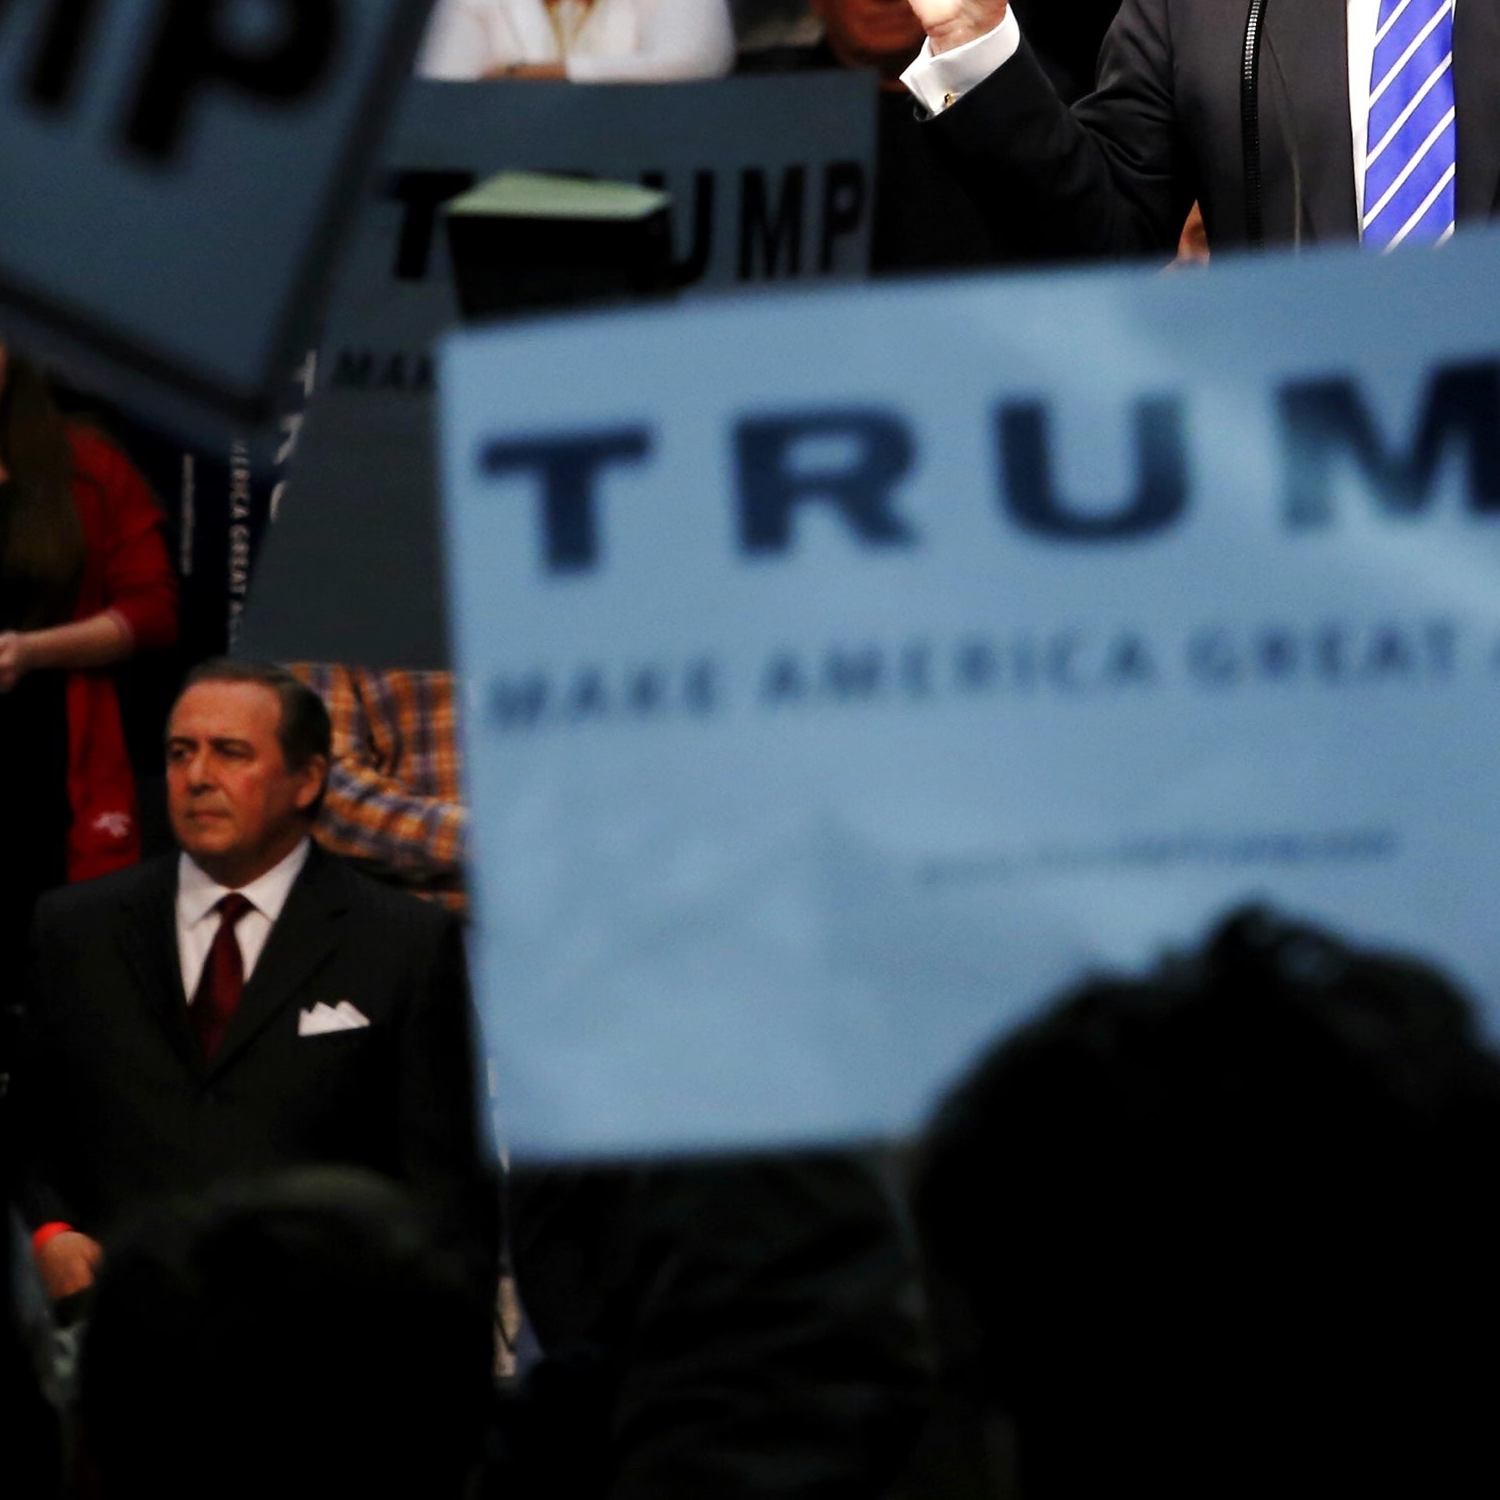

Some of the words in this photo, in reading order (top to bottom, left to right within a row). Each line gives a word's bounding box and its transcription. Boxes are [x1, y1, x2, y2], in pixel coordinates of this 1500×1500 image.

[390, 160, 866, 291] TUMP
[484, 660, 722, 738] MAKE
[758, 630, 1155, 708] AMERICA
[1183, 620, 1461, 690] GREAT
